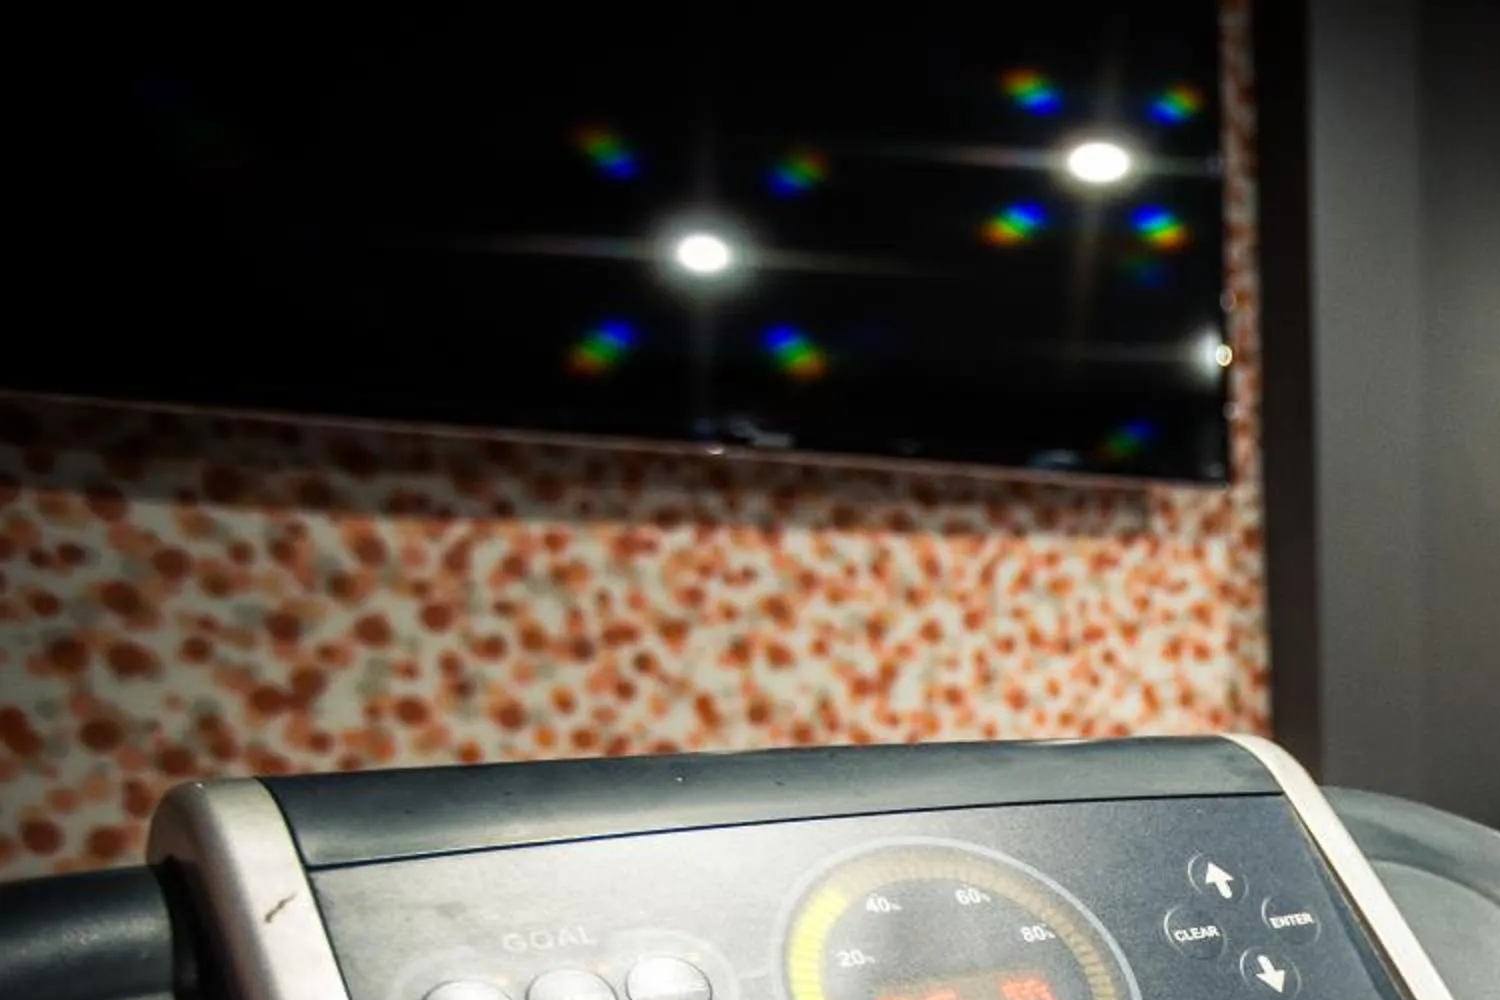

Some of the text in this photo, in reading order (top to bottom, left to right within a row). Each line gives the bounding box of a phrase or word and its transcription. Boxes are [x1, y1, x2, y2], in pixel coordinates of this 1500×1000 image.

[1270, 911, 1315, 929] ENTER
[502, 926, 596, 950] GOAL
[1172, 925, 1220, 942] CLEAR
